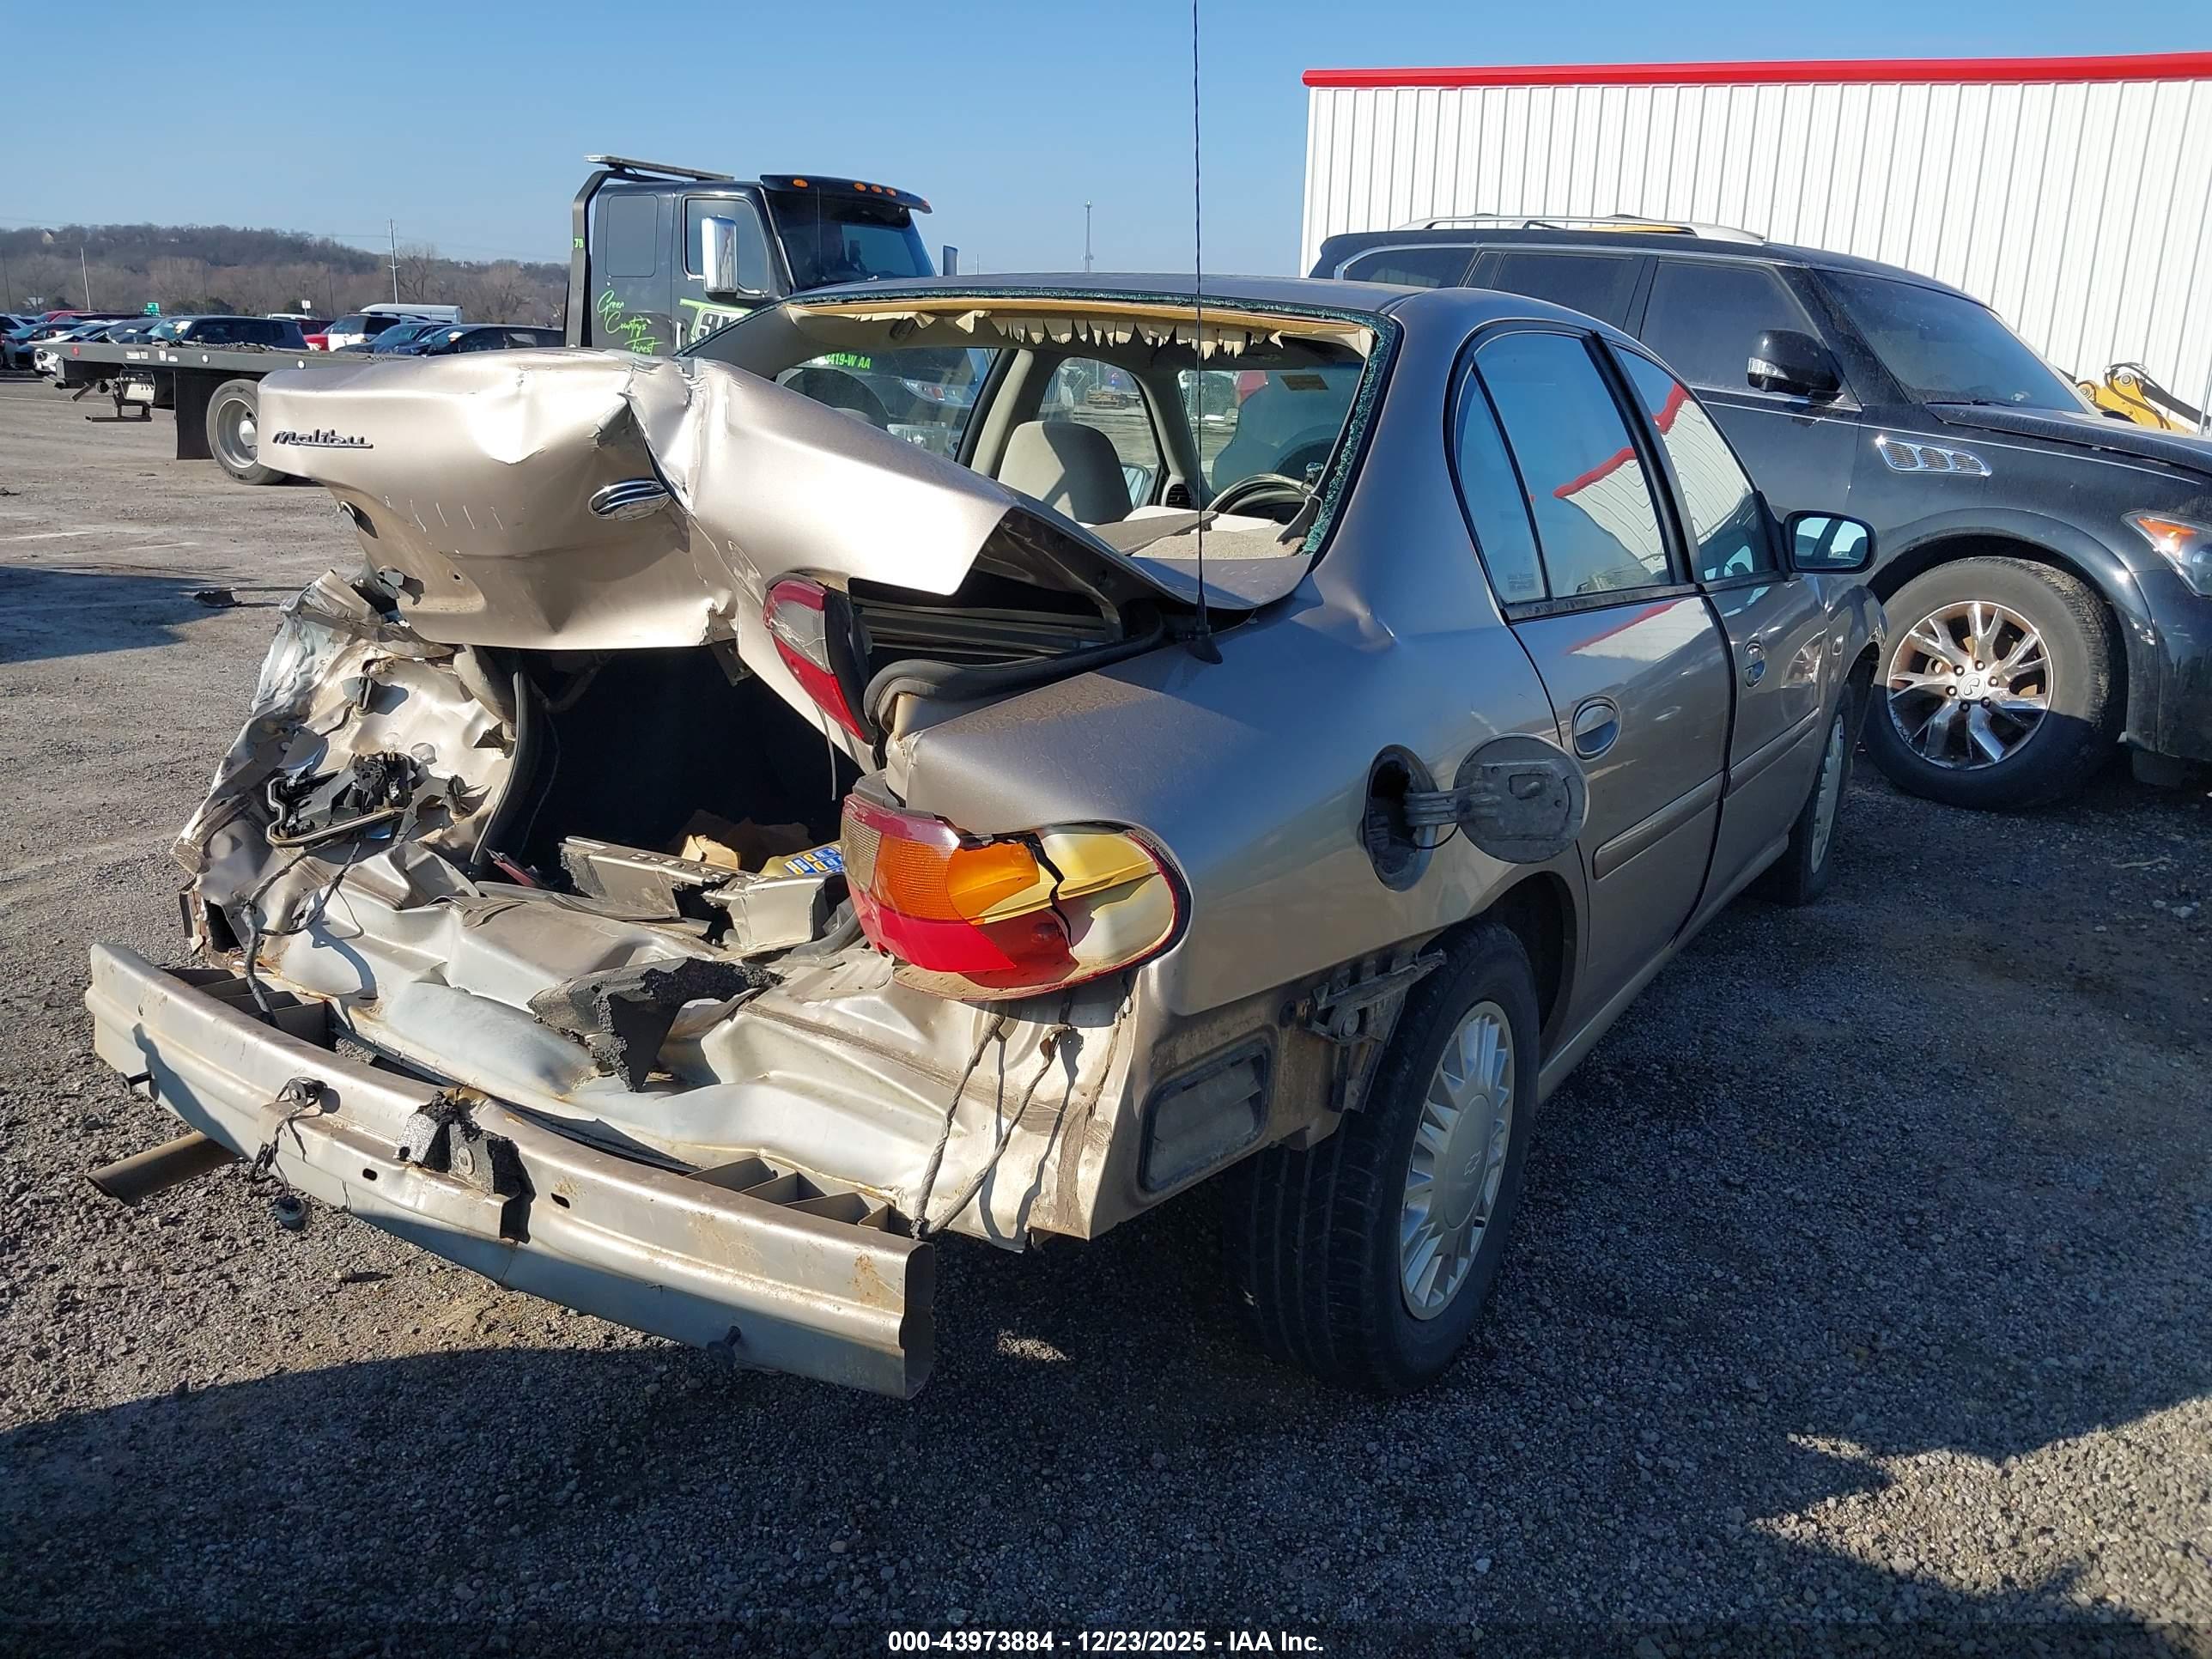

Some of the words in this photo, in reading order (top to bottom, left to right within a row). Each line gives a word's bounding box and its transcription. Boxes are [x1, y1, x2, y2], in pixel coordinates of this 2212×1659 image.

[597, 289, 625, 321] Green
[624, 337, 663, 356] Finest
[858, 356, 872, 369] AA
[272, 428, 374, 449] Malibu
